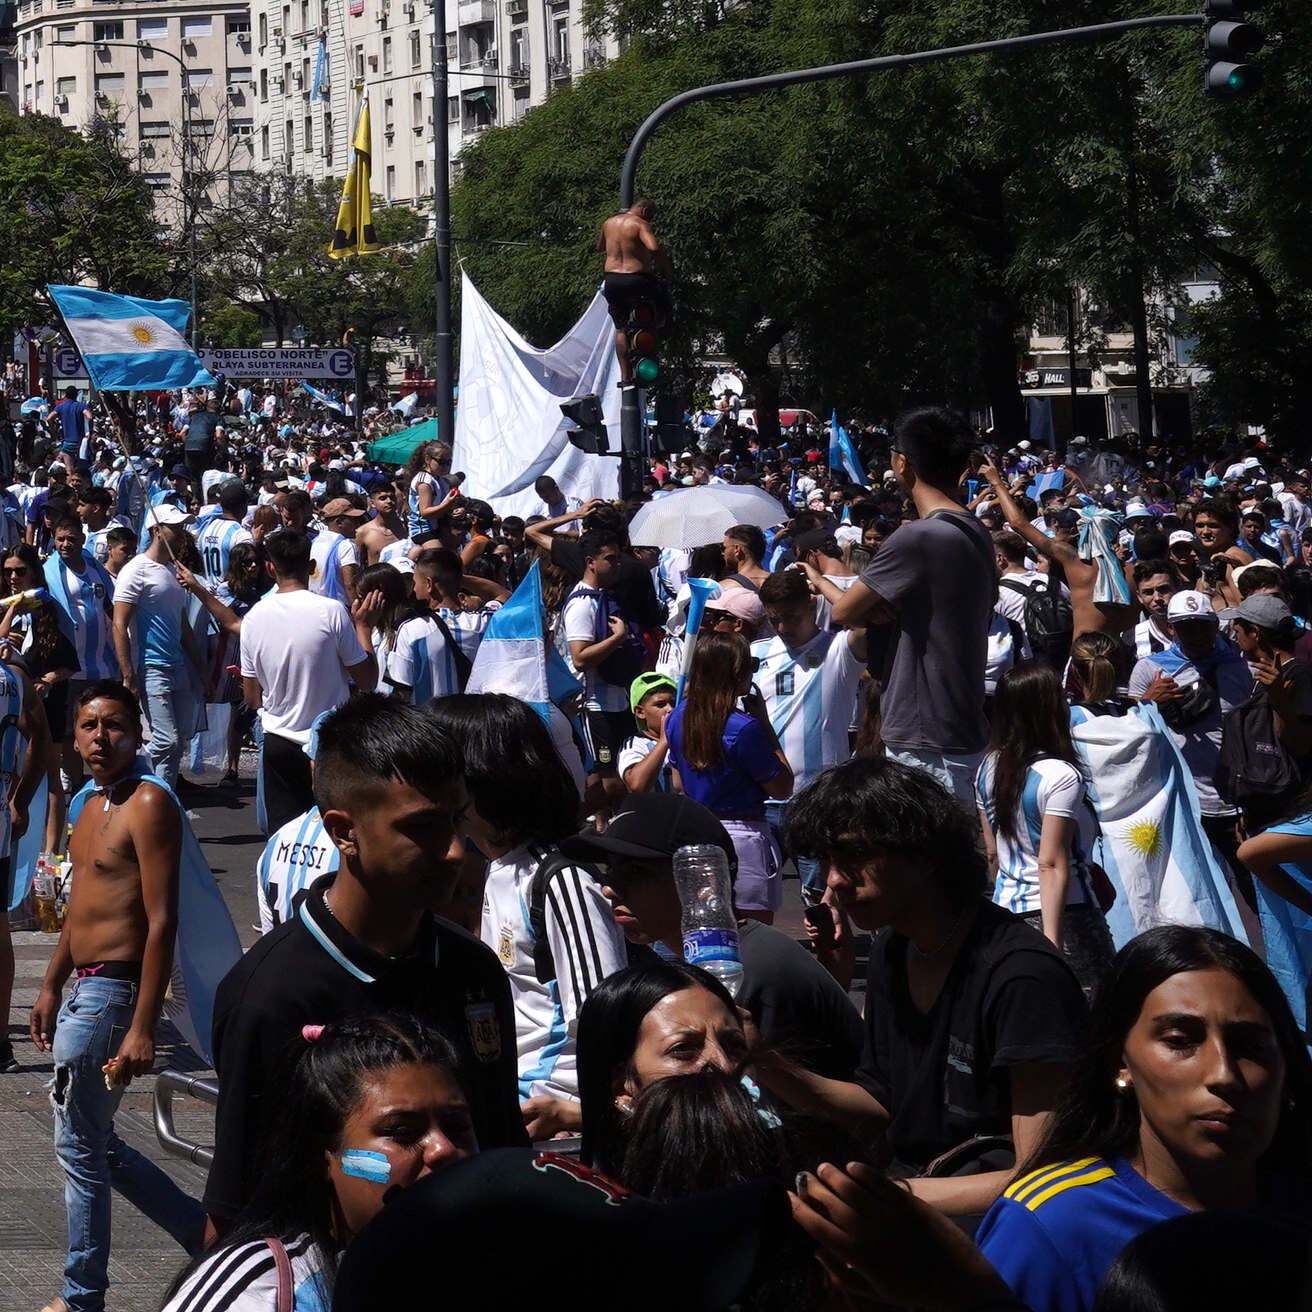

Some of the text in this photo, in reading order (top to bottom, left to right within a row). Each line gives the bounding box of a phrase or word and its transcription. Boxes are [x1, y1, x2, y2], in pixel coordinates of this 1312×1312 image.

[212, 361, 325, 369] PLAYA SUBTERRANEA
[203, 546, 222, 577] 10
[776, 671, 795, 696] 10
[276, 840, 326, 869] MESSI
